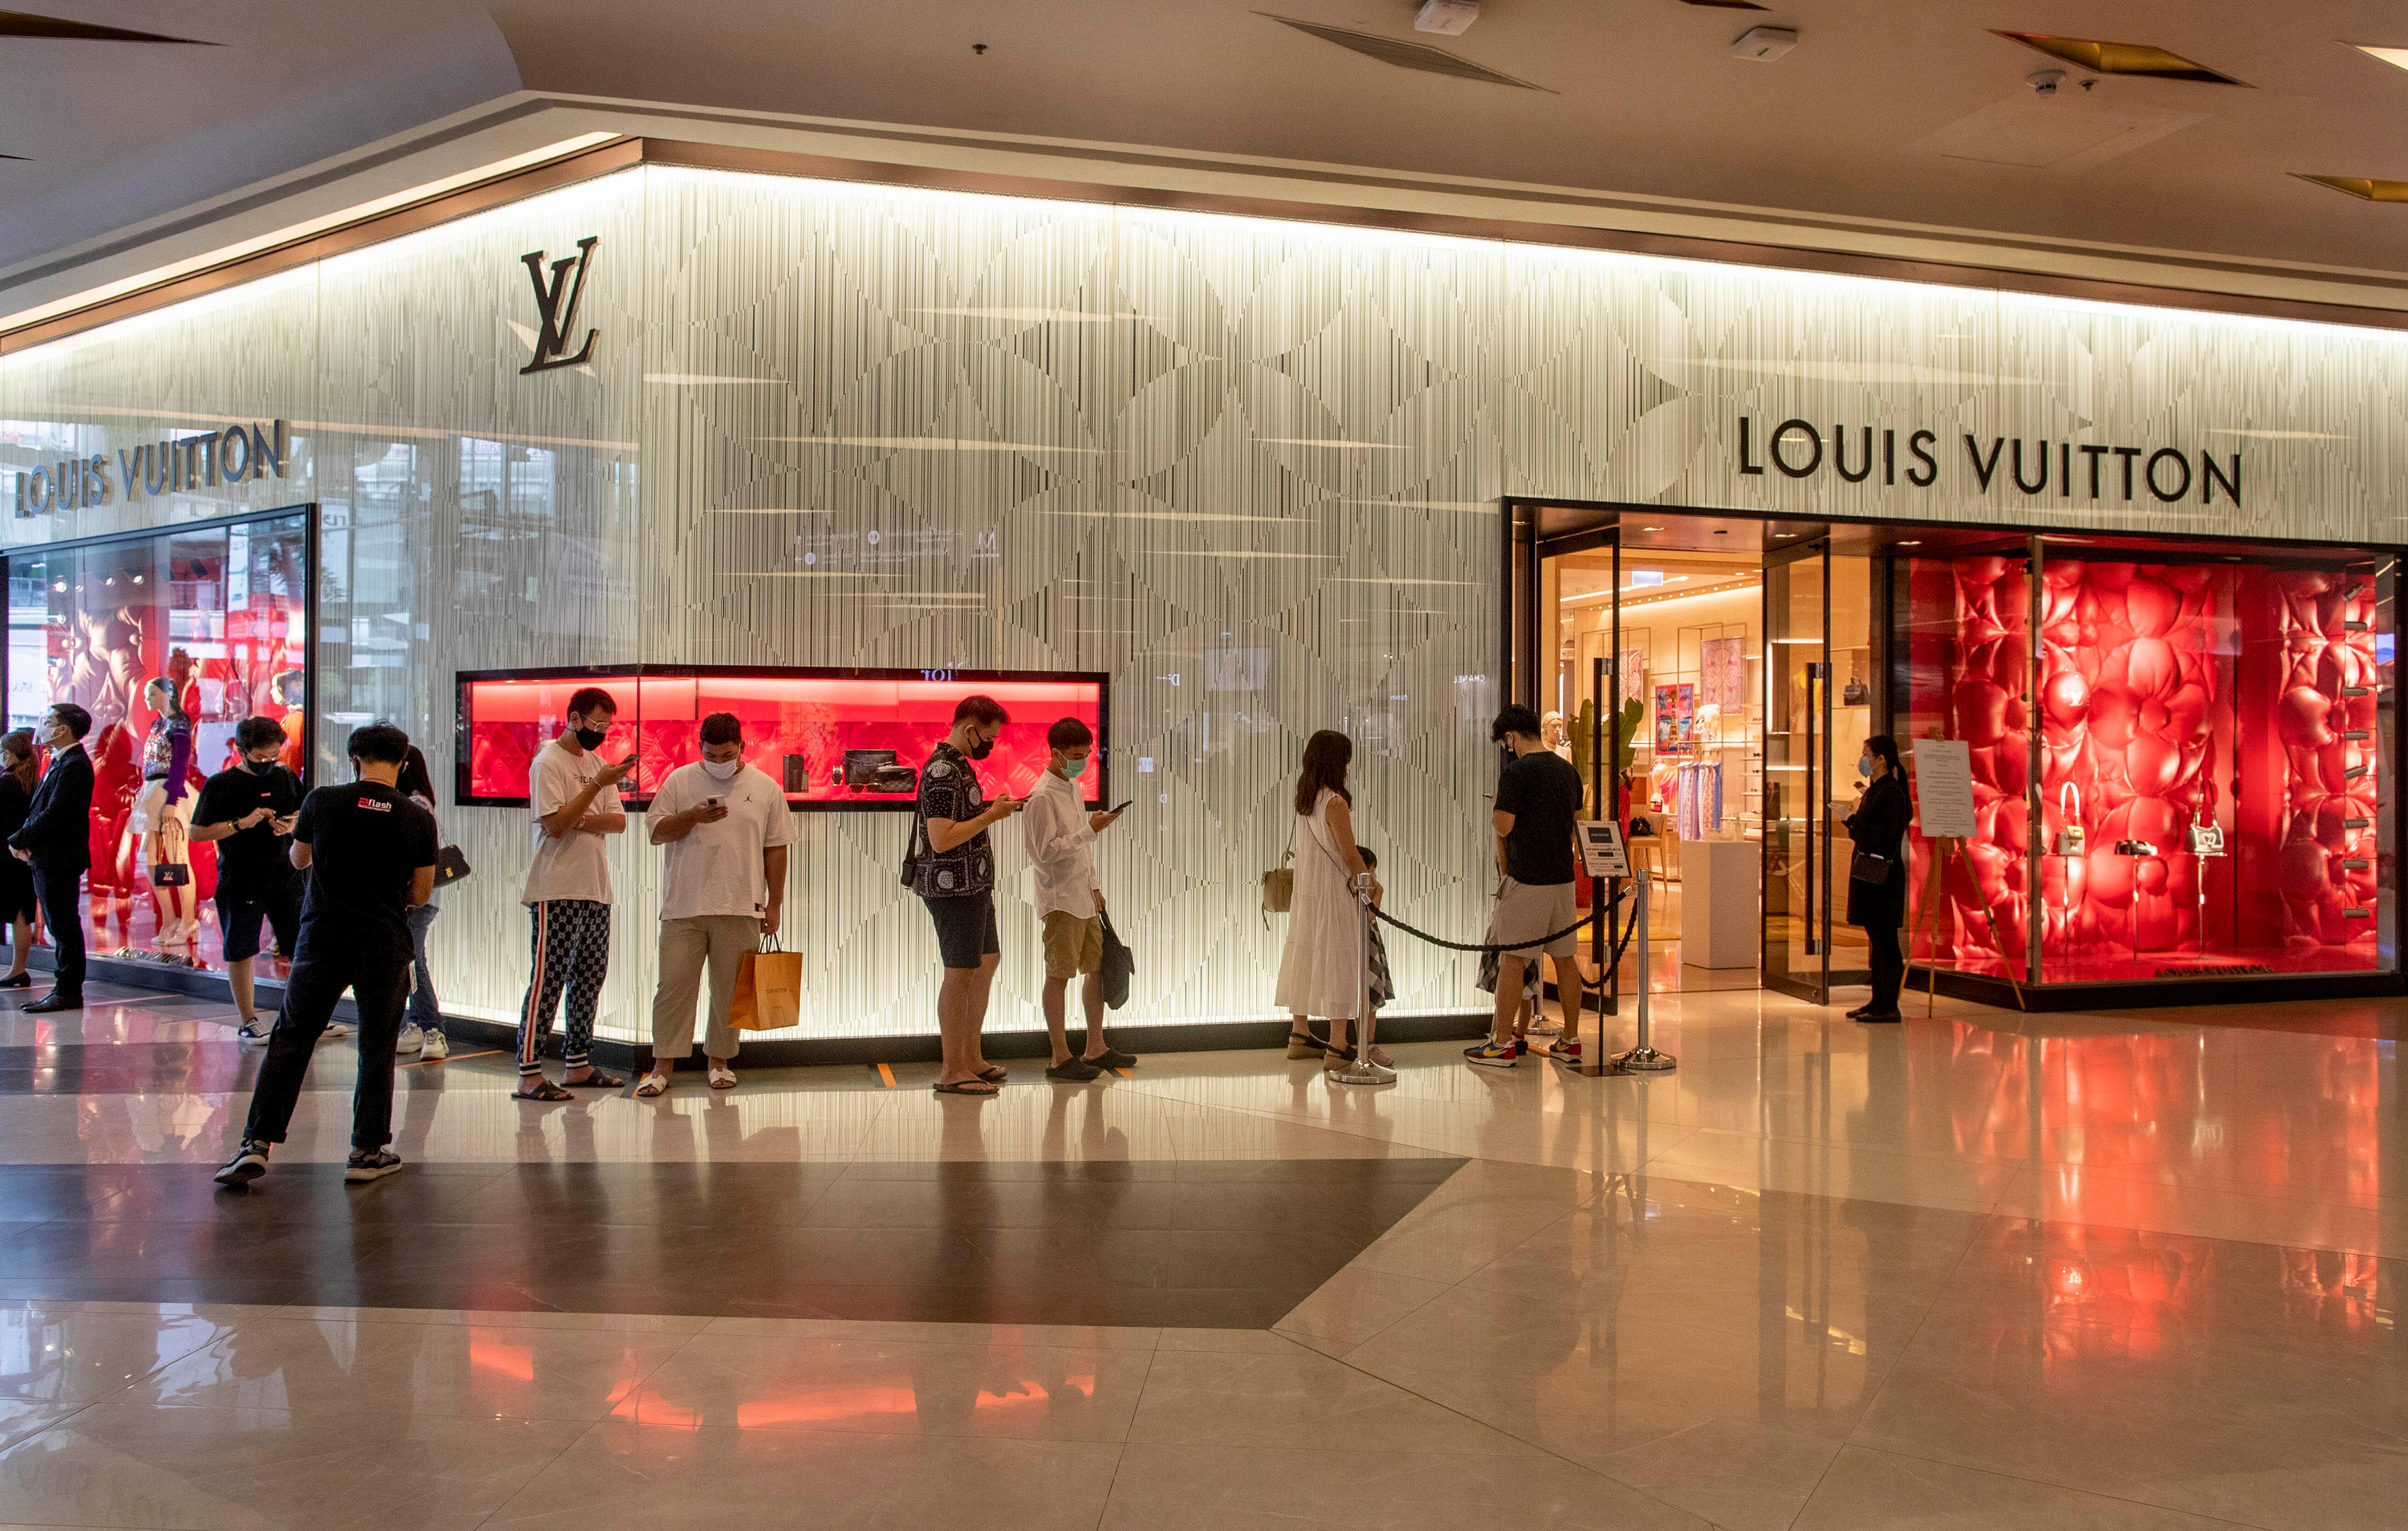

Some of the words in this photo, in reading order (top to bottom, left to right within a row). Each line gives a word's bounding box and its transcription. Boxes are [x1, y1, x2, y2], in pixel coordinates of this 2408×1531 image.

[519, 236, 600, 375] LV
[15, 454, 111, 519] LOUIS
[118, 419, 287, 502] VUITTON
[1740, 417, 1938, 487] LOUIS
[1966, 434, 2241, 508] VUITTON
[368, 799, 392, 809] flash
